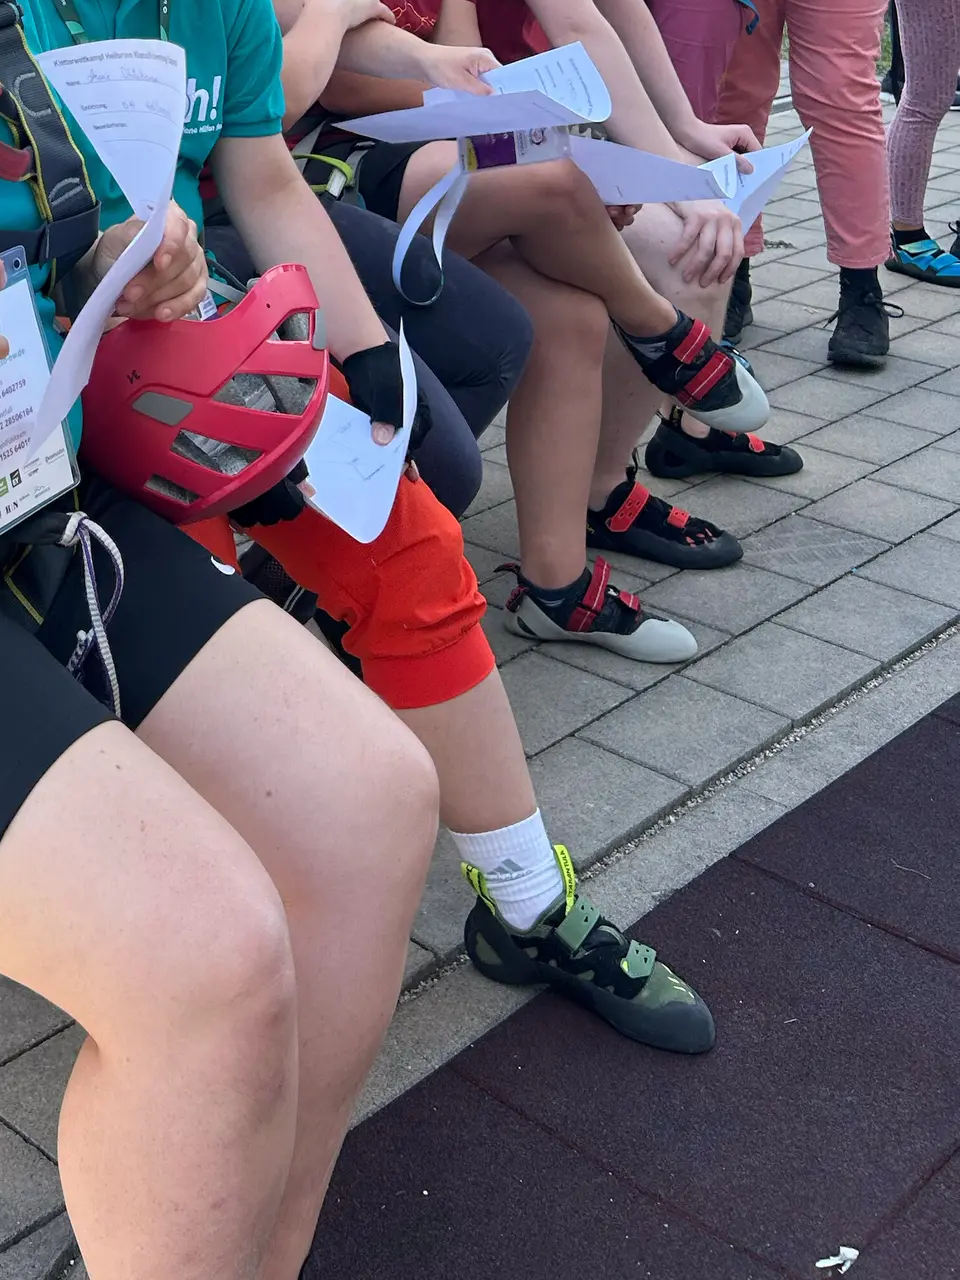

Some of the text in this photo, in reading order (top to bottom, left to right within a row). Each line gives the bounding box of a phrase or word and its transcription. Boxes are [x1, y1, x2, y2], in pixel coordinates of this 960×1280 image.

[2, 379, 27, 398] 6402759
[5, 406, 34, 427] 28506184
[0, 448, 14, 461] 1525
